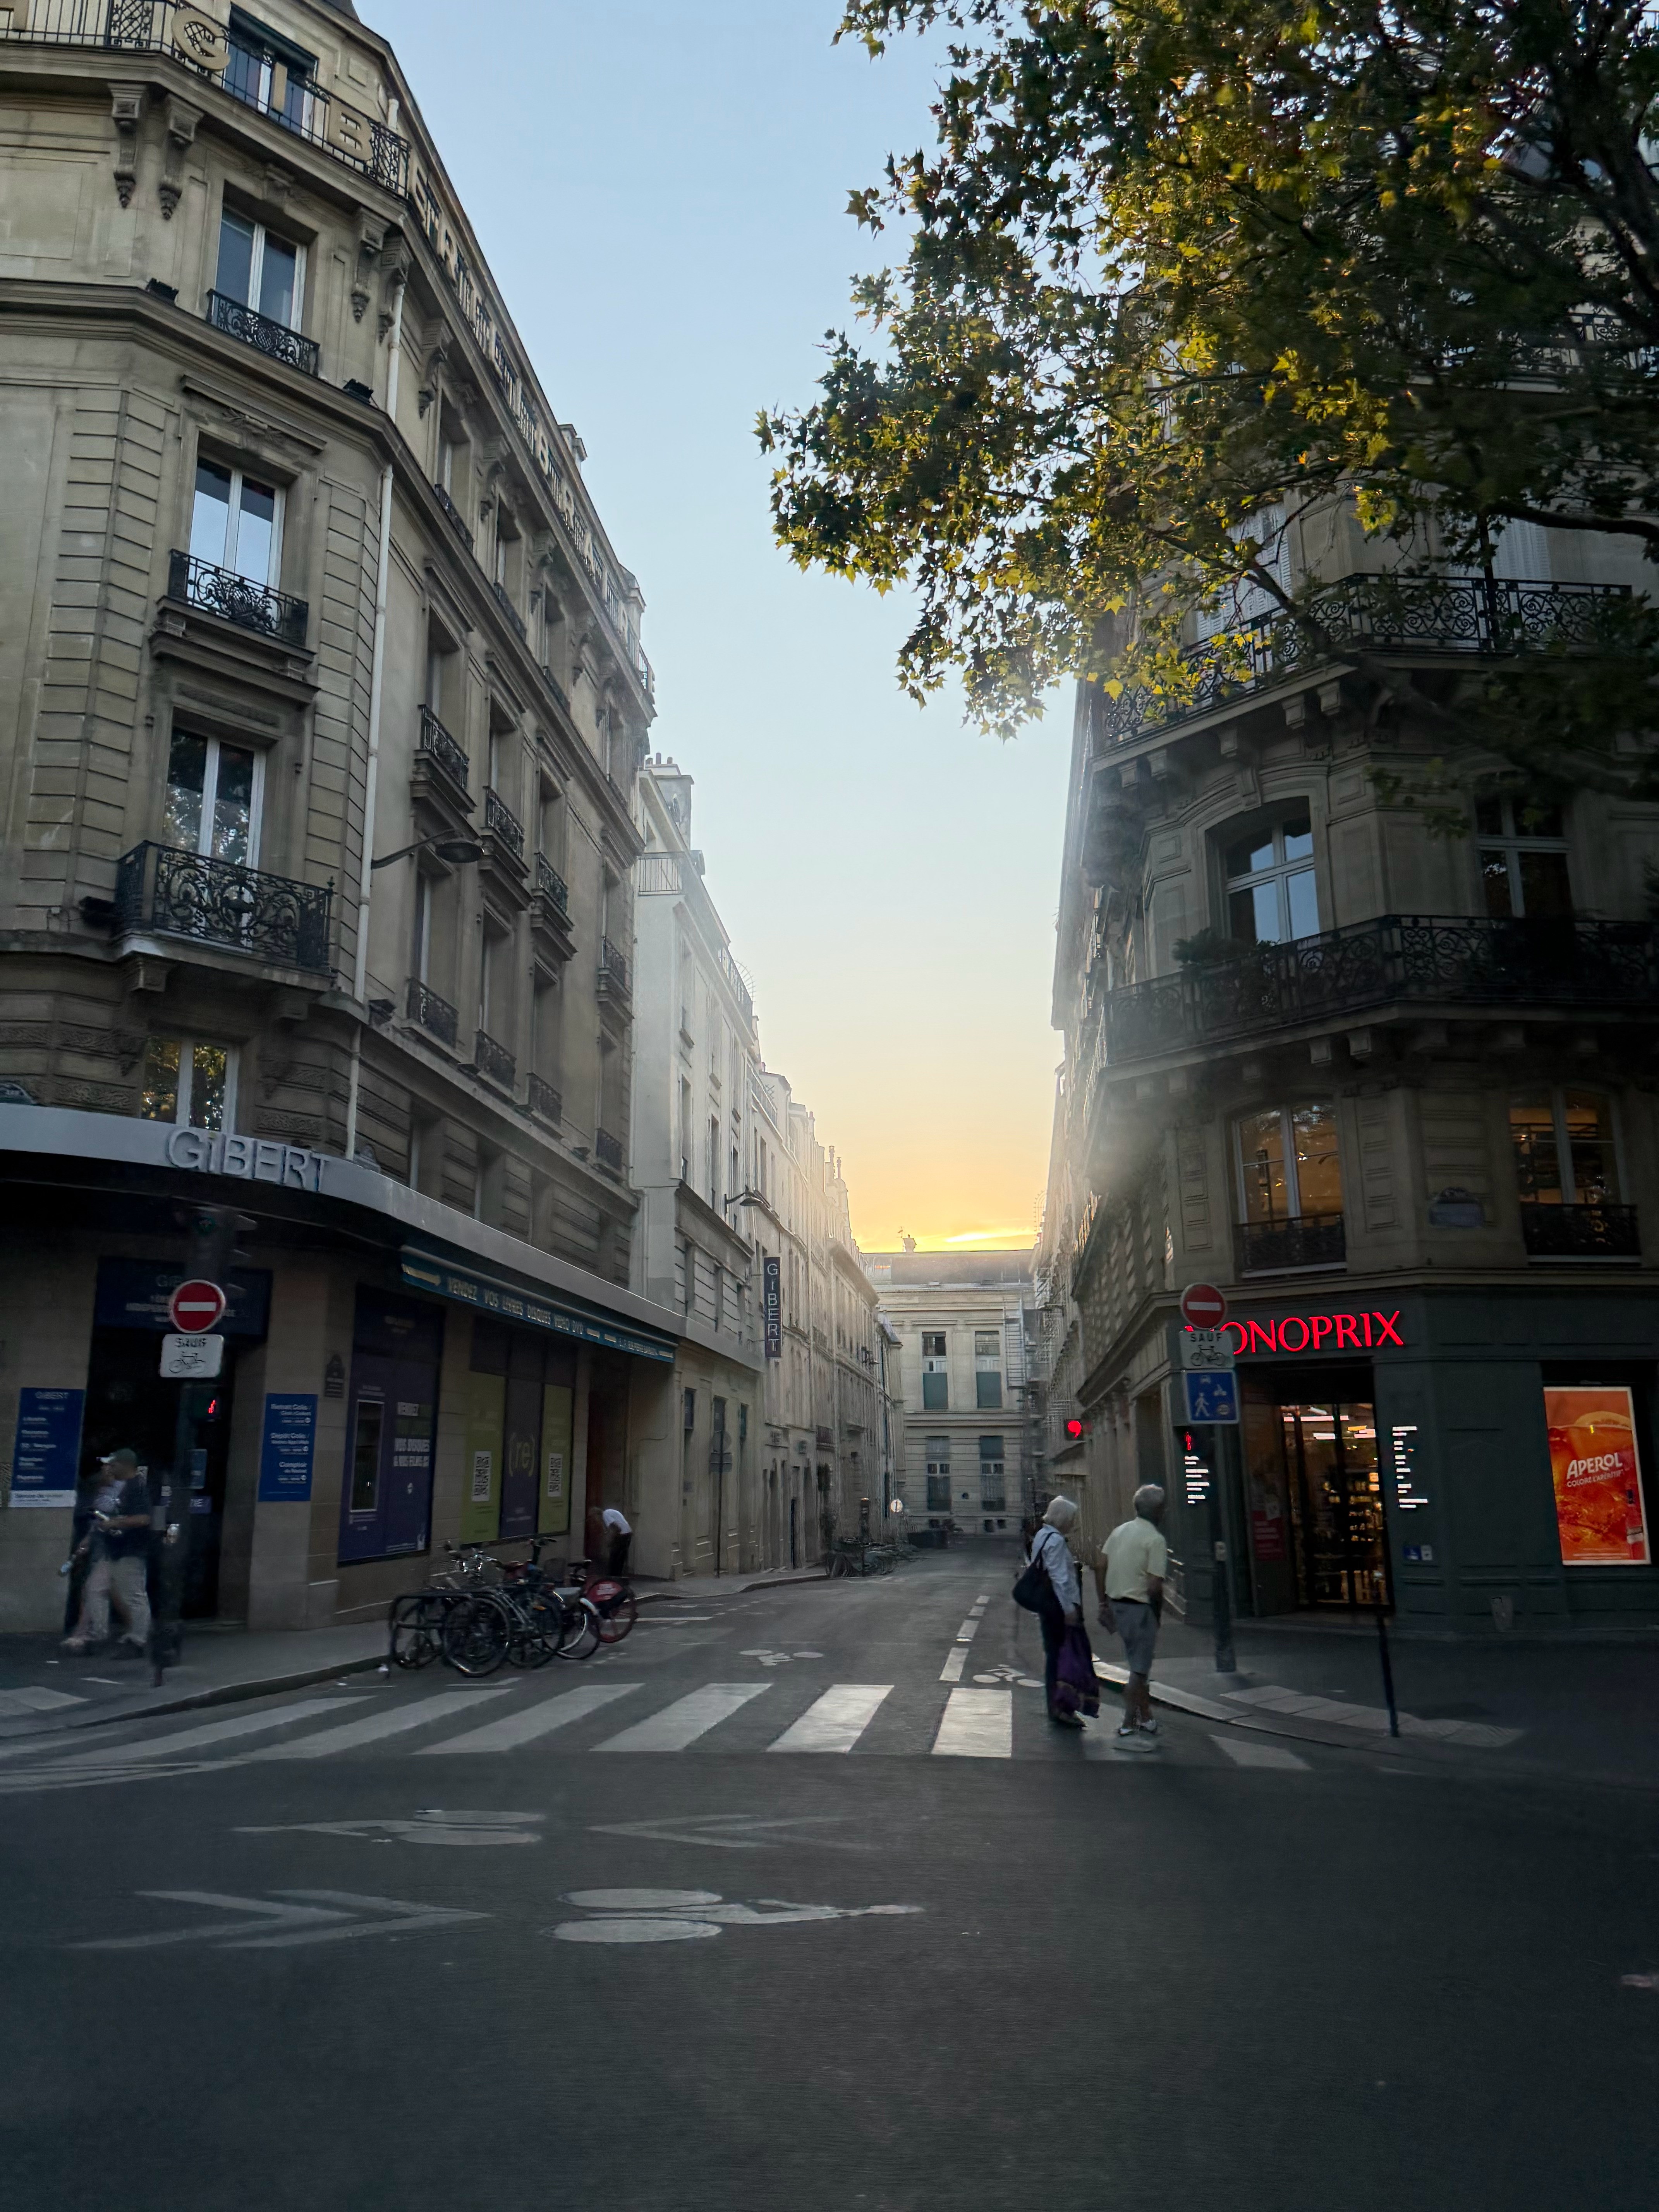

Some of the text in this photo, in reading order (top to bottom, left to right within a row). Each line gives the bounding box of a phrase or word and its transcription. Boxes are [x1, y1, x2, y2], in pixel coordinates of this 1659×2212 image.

[1184, 1310, 1405, 1355] ONOPRIX
[1190, 1333, 1223, 1342] SAUF
[174, 1338, 207, 1348] SAUF
[1566, 1452, 1623, 1480] APEROL
